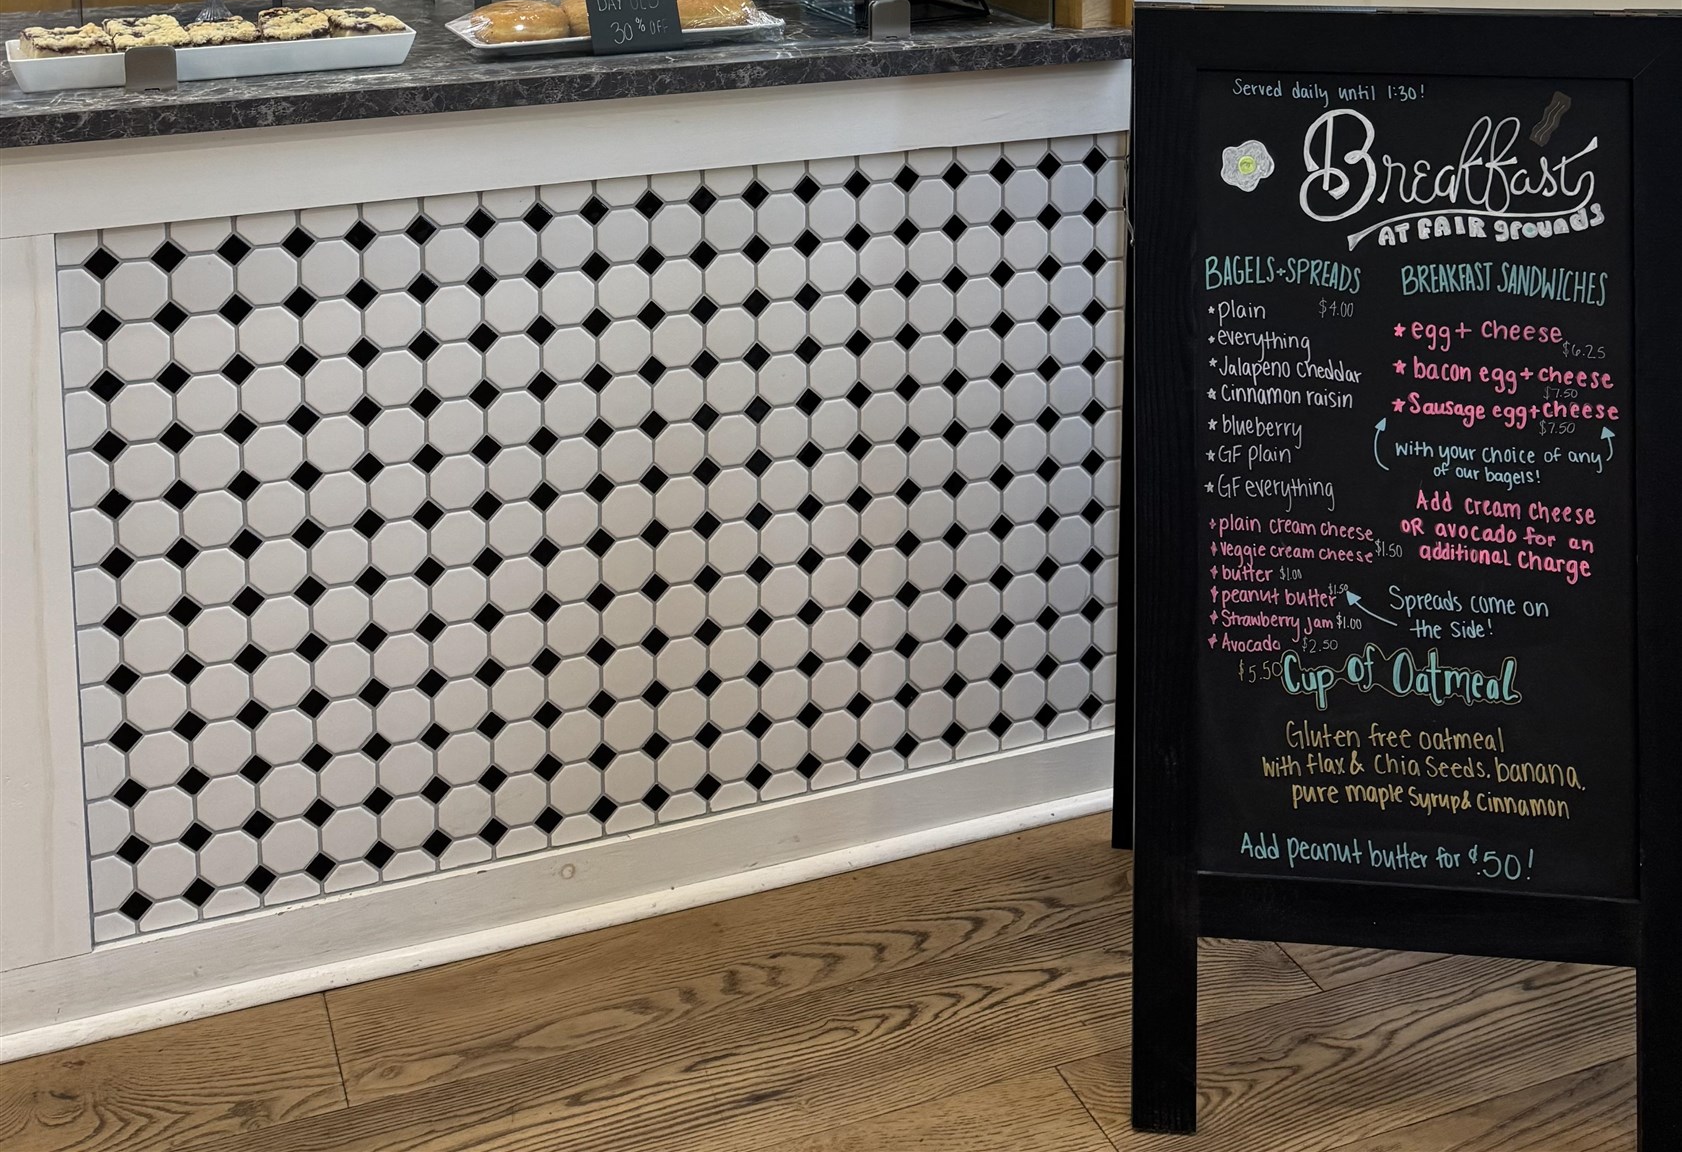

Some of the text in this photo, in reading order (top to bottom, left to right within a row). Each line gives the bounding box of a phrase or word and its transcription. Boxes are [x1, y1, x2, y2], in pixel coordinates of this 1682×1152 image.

[1233, 79, 1425, 107] Served daily until 1:30!
[1378, 203, 1605, 246] AT FAIR grounds
[1402, 262, 1608, 306] BREAKFAST SANDWICHES
[1218, 297, 1354, 327] plain $4.00
[1218, 329, 1310, 363] everything
[1411, 321, 1450, 352] egg
[1562, 341, 1606, 359] $6.25
[1414, 356, 1472, 382] bacon
[1306, 389, 1353, 408] raisin
[1222, 414, 1302, 449] blueberry
[1218, 444, 1291, 470] GF plain
[1439, 446, 1603, 473] your of any
[1434, 462, 1541, 491] of our bagels!
[1218, 474, 1335, 512] GF everything
[1416, 489, 1521, 520] Add cream
[1219, 514, 1374, 541] plain cream cheese
[1435, 524, 1594, 553] avocado for an
[1270, 539, 1403, 563] cream cheese $1.50
[1222, 565, 1273, 582] butter
[1222, 589, 1336, 608] peanut butter
[1389, 585, 1549, 617] Spreads come on
[1336, 612, 1362, 630] $1.00
[1410, 619, 1441, 639] the
[1222, 633, 1280, 652] Avocado
[1283, 647, 1519, 708] Cup of Oatmeal
[1286, 720, 1505, 753] Gluten free oatmeal
[1306, 751, 1344, 776] flax
[1292, 783, 1404, 810] pure maple
[1241, 832, 1461, 871] Add peanut butter for
